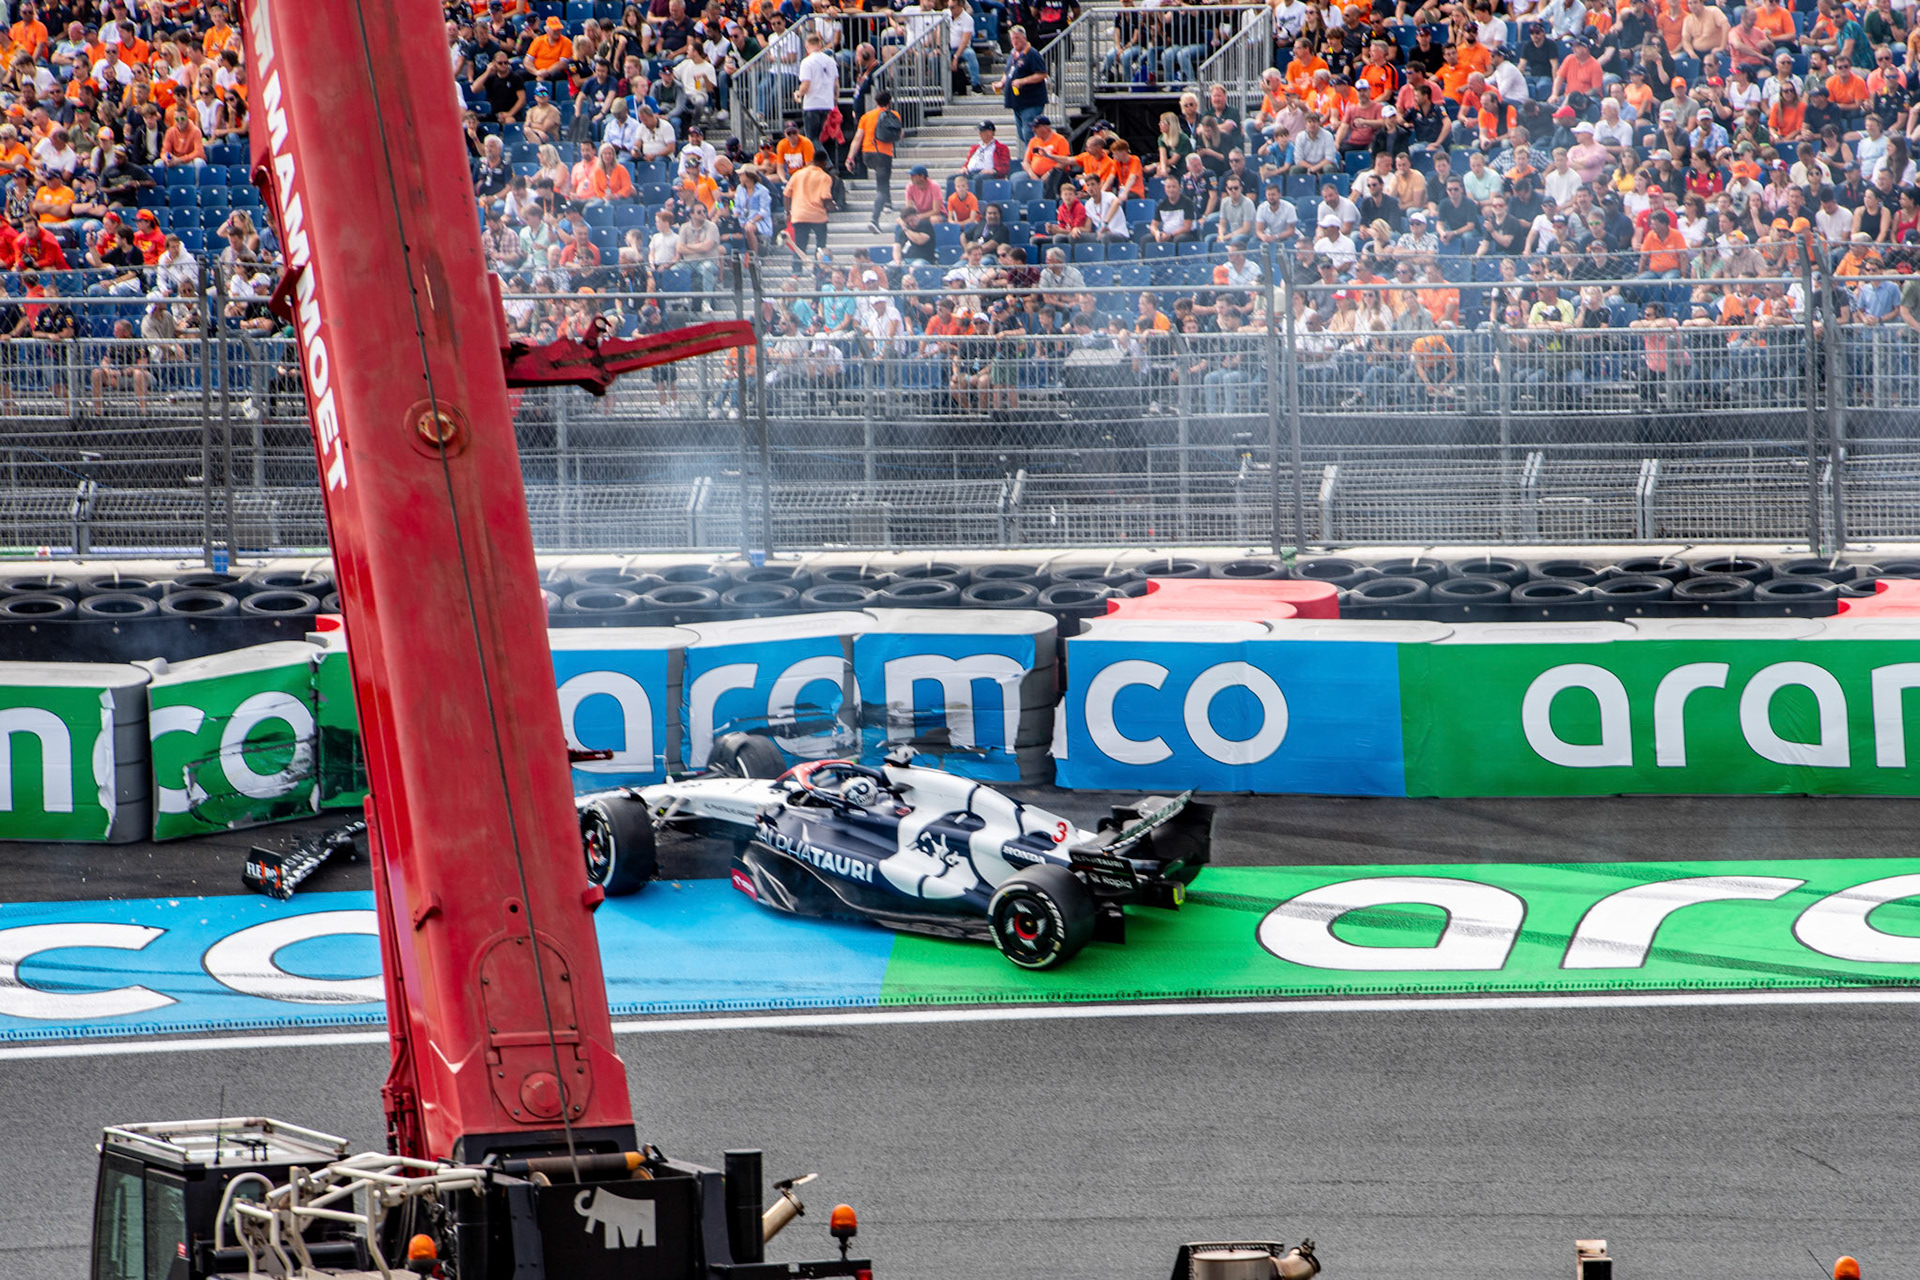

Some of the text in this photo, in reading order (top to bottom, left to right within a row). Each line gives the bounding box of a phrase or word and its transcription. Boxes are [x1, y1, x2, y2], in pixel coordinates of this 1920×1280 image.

[262, 69, 348, 492] MAMMOET
[557, 655, 1289, 773] aramco
[757, 824, 874, 884] ALPHATAURI
[1003, 845, 1047, 864] HONDA
[1053, 821, 1068, 843] 3
